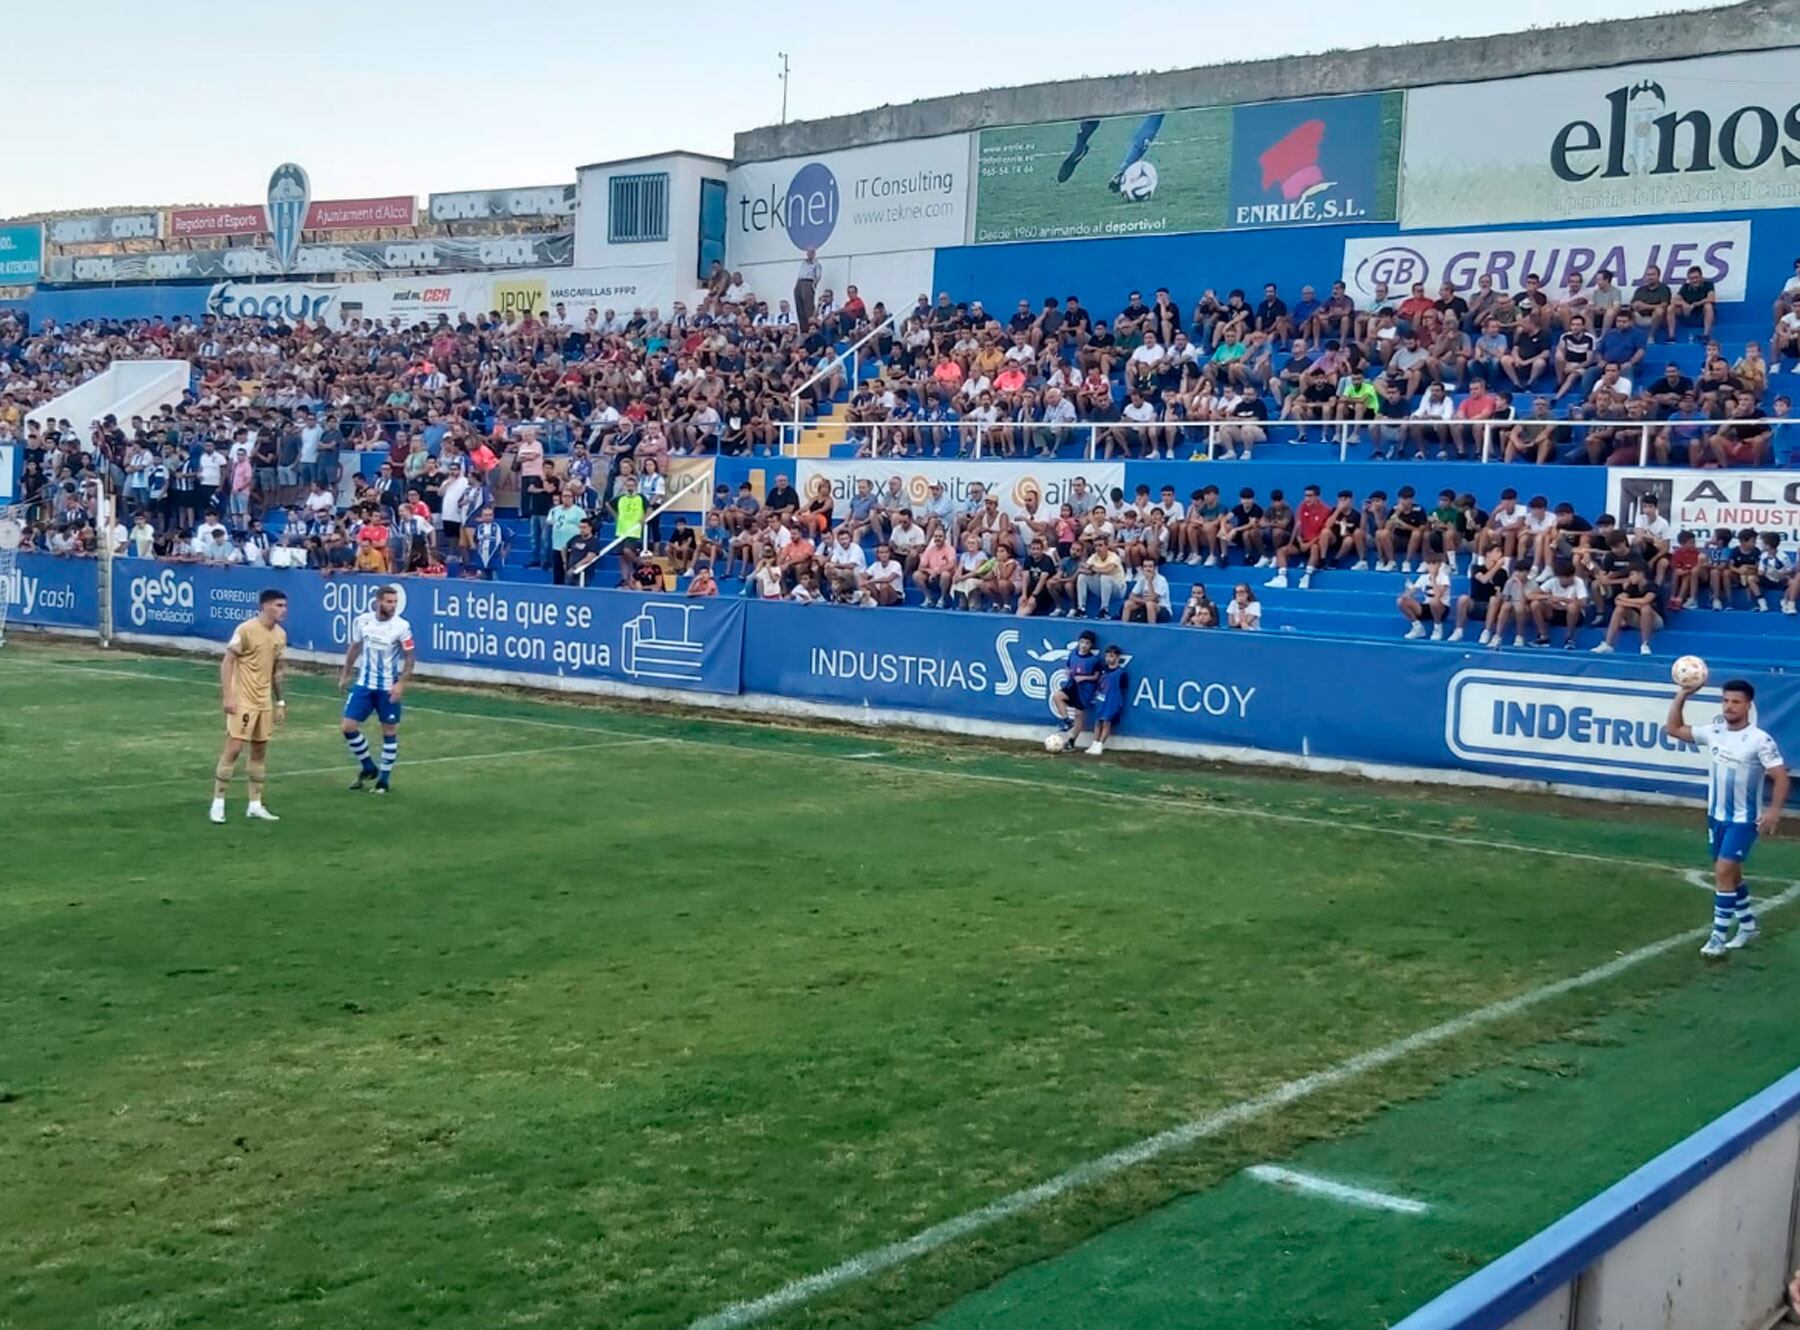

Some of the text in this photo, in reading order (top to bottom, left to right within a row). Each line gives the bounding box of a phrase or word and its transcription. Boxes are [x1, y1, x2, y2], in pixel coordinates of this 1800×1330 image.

[855, 170, 953, 200] IT Consulting
[316, 208, 374, 226] Ajuntament
[739, 178, 835, 232] teknei
[852, 200, 953, 226] www.teknei.com
[1013, 226, 1038, 240] 1960
[1038, 223, 1091, 238] animando
[1104, 218, 1167, 235] deportivo!
[1442, 239, 1734, 291] GRUPAJES
[551, 287, 611, 299] MASCARILLAS
[1680, 507, 1800, 526] LA INDUST
[39, 584, 75, 609] cash
[433, 589, 592, 630] La tela que se
[432, 623, 611, 671] limpia con agua
[810, 647, 987, 692] INDUSTRIAS
[1132, 677, 1256, 718] ALCOY
[242, 712, 250, 728] 9
